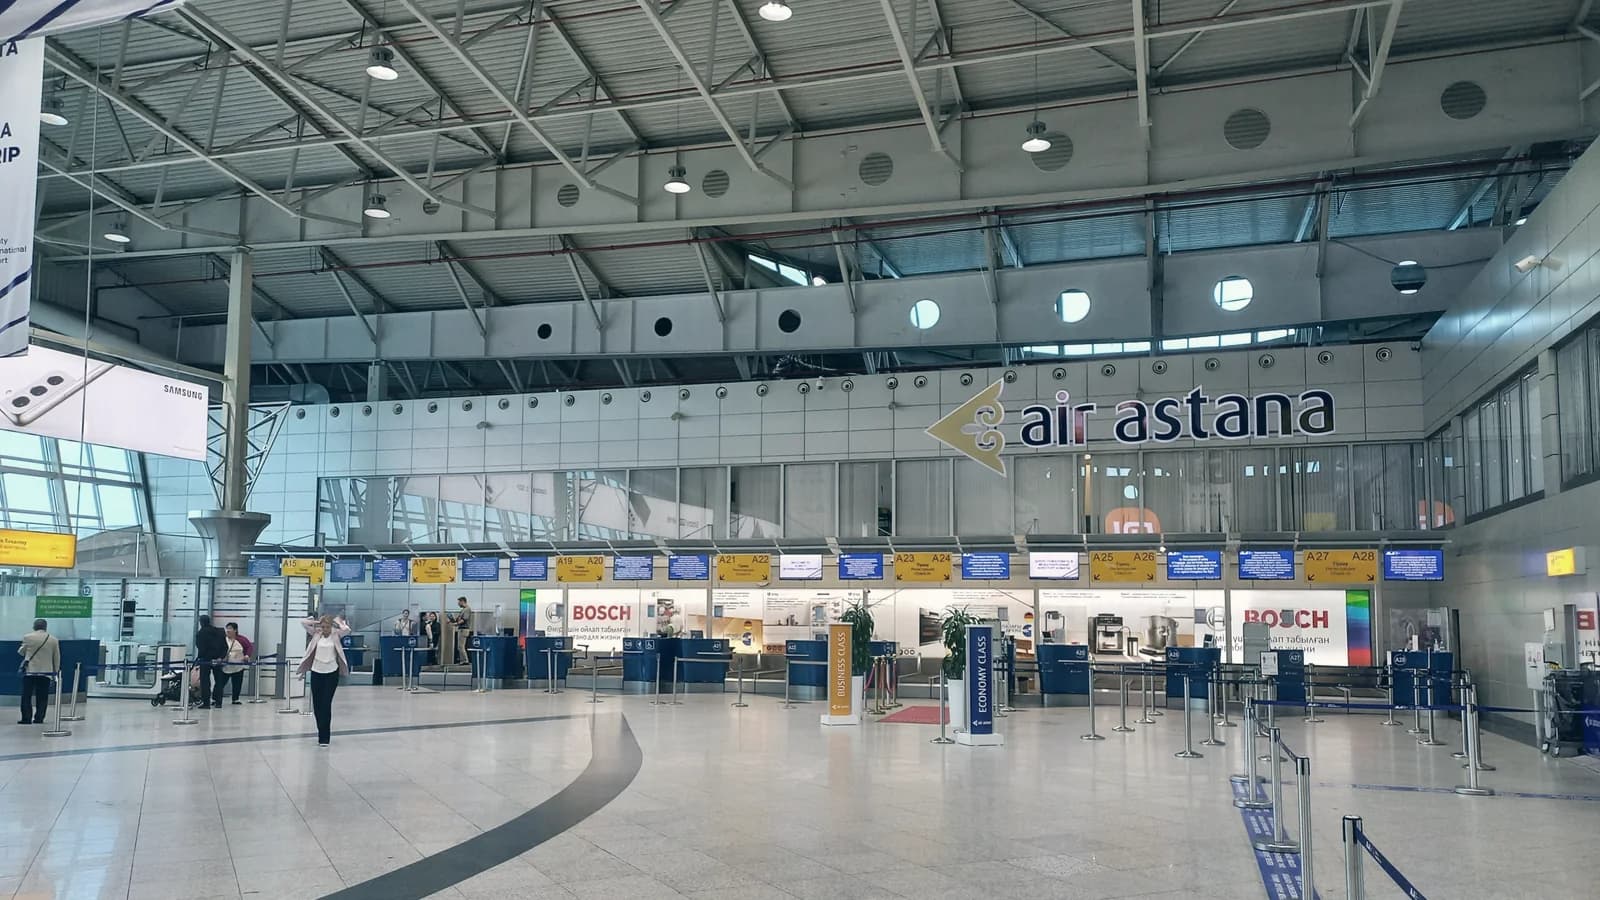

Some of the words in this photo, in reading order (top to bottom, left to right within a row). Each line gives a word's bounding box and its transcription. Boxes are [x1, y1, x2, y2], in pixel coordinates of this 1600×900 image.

[0, 146, 20, 163] IP
[163, 384, 203, 401] SAMSUNG
[1020, 390, 1096, 448] air
[1113, 384, 1336, 444] astana
[558, 557, 573, 565] A19
[587, 557, 604, 565] A20
[719, 555, 736, 564] A21
[752, 555, 769, 564] A22
[896, 554, 914, 562] A23
[932, 554, 951, 562] A24
[1093, 552, 1114, 562] A25
[1133, 552, 1155, 562] A26
[1306, 551, 1329, 561] A27
[1352, 551, 1375, 561] A28
[283, 560, 297, 568] A15
[310, 560, 324, 568] A16
[441, 559, 456, 567] A18
[573, 605, 631, 620] BOSCH
[837, 631, 846, 656] CLASS
[1286, 635, 1330, 644] табылған
[977, 635, 987, 664] CLASS
[837, 658, 846, 697] BUSINESS
[977, 666, 987, 713] ECONOMY
